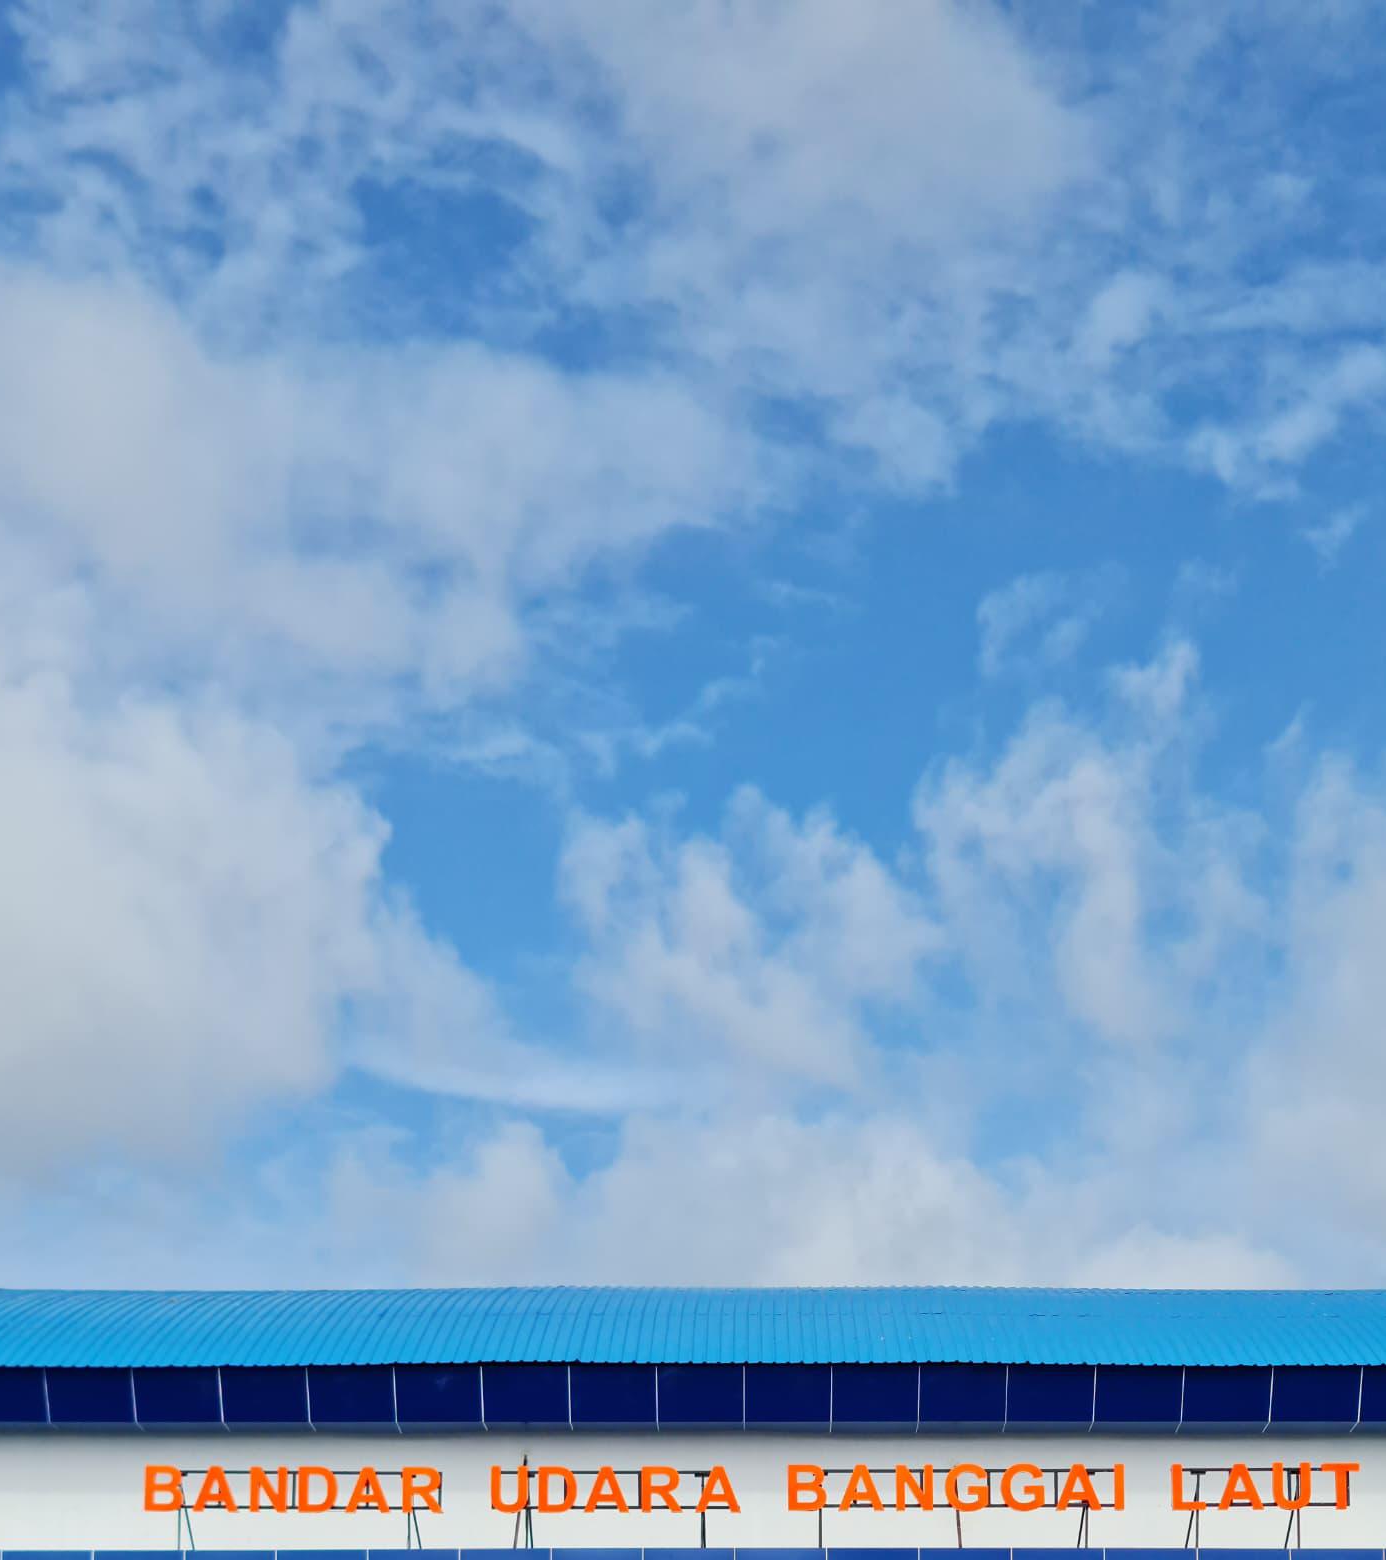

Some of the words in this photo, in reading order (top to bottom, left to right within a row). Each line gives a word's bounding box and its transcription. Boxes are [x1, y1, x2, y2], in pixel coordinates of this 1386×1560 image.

[143, 1464, 443, 1514] BANDAR
[490, 1464, 741, 1513] UDARA
[786, 1462, 1125, 1512] BANGGAI
[1169, 1462, 1360, 1511] LAUT
